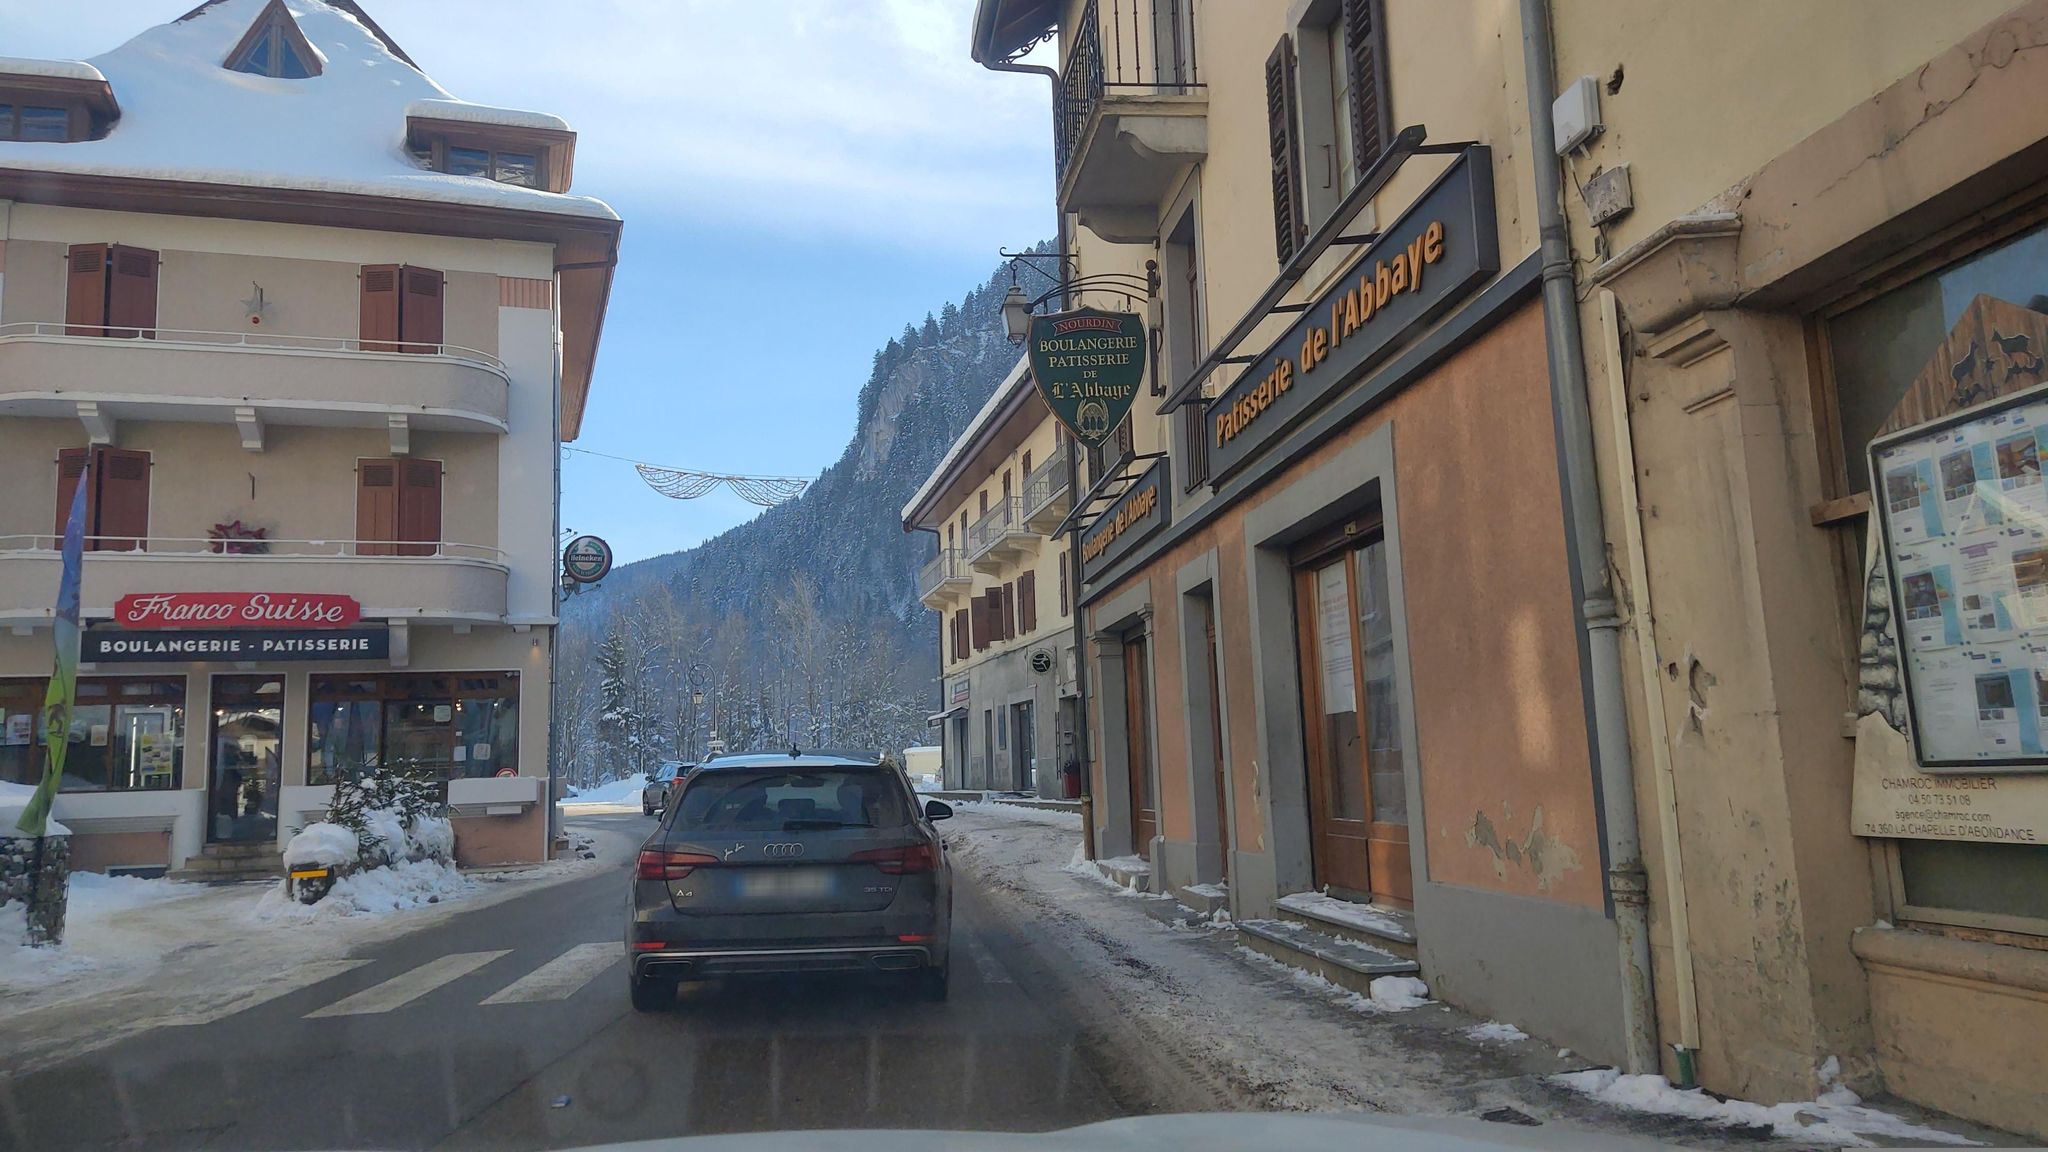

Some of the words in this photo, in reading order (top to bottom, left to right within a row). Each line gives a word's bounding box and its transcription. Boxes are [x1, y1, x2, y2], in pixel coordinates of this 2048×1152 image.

[1059, 319, 1115, 332] NOURDIN
[1216, 357, 1293, 448] Patisserie
[1301, 327, 1328, 374] de
[1331, 220, 1444, 348] l'Abbaye
[1039, 336, 1138, 352] BOULANGERIE
[1048, 353, 1130, 368] PATISSERIE
[1083, 370, 1098, 379] DE
[1051, 381, 1131, 400] L'Abbaye
[1115, 509, 1126, 536] de
[570, 554, 603, 562] Heineken
[127, 595, 237, 621] Franco
[241, 594, 345, 622] Suisse
[100, 640, 241, 653] BOULANGERIE
[262, 638, 370, 652] PATISSERIE
[1881, 777, 1932, 790] CHAMROC
[1934, 777, 1998, 790] IMMOBILIER
[1896, 824, 1907, 834] LA
[1908, 824, 1957, 836] CHAPELLE
[1959, 825, 2036, 841] D'ABONDANCE
[676, 889, 693, 897] A4
